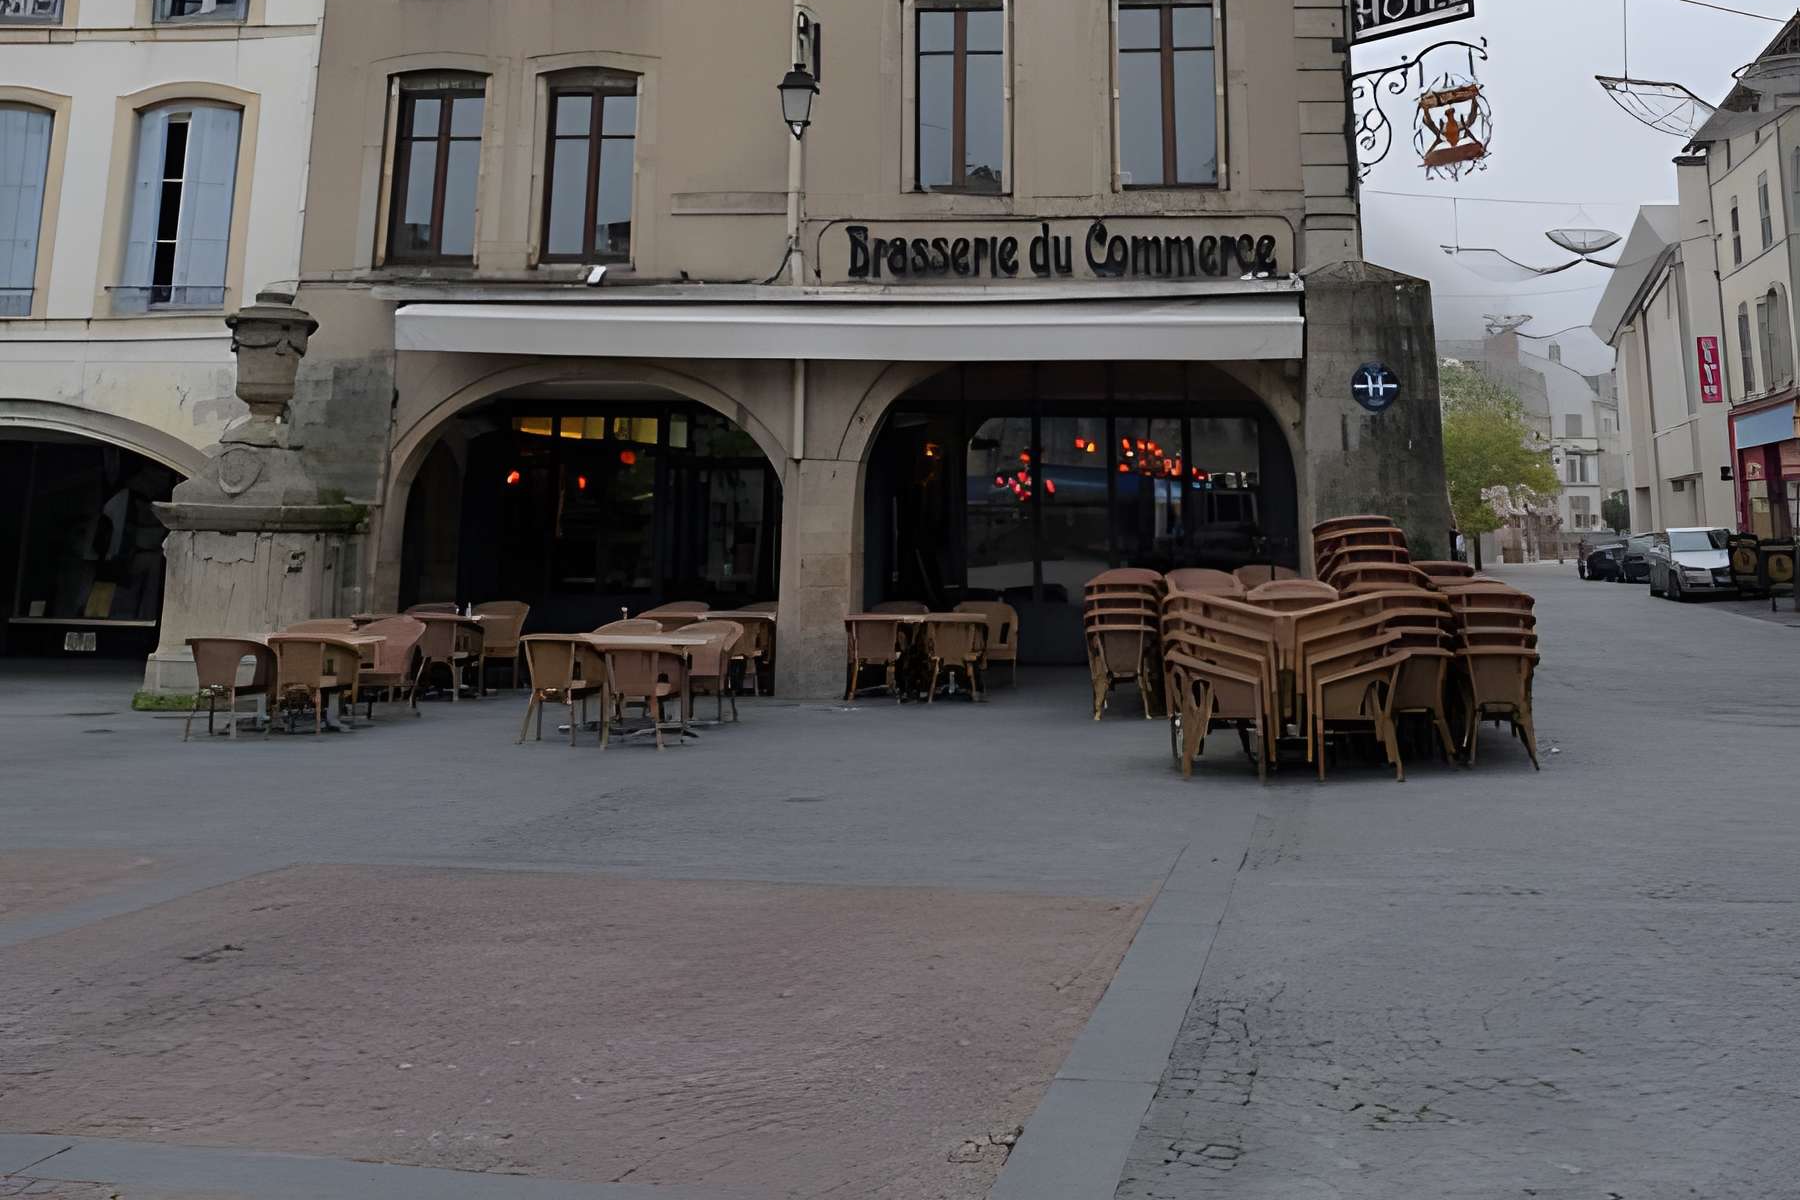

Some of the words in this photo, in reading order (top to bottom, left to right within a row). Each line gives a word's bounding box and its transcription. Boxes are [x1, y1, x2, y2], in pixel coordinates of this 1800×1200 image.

[846, 225, 1019, 278] Brasserie
[1029, 223, 1073, 278] du
[1085, 222, 1278, 278] Commerce
